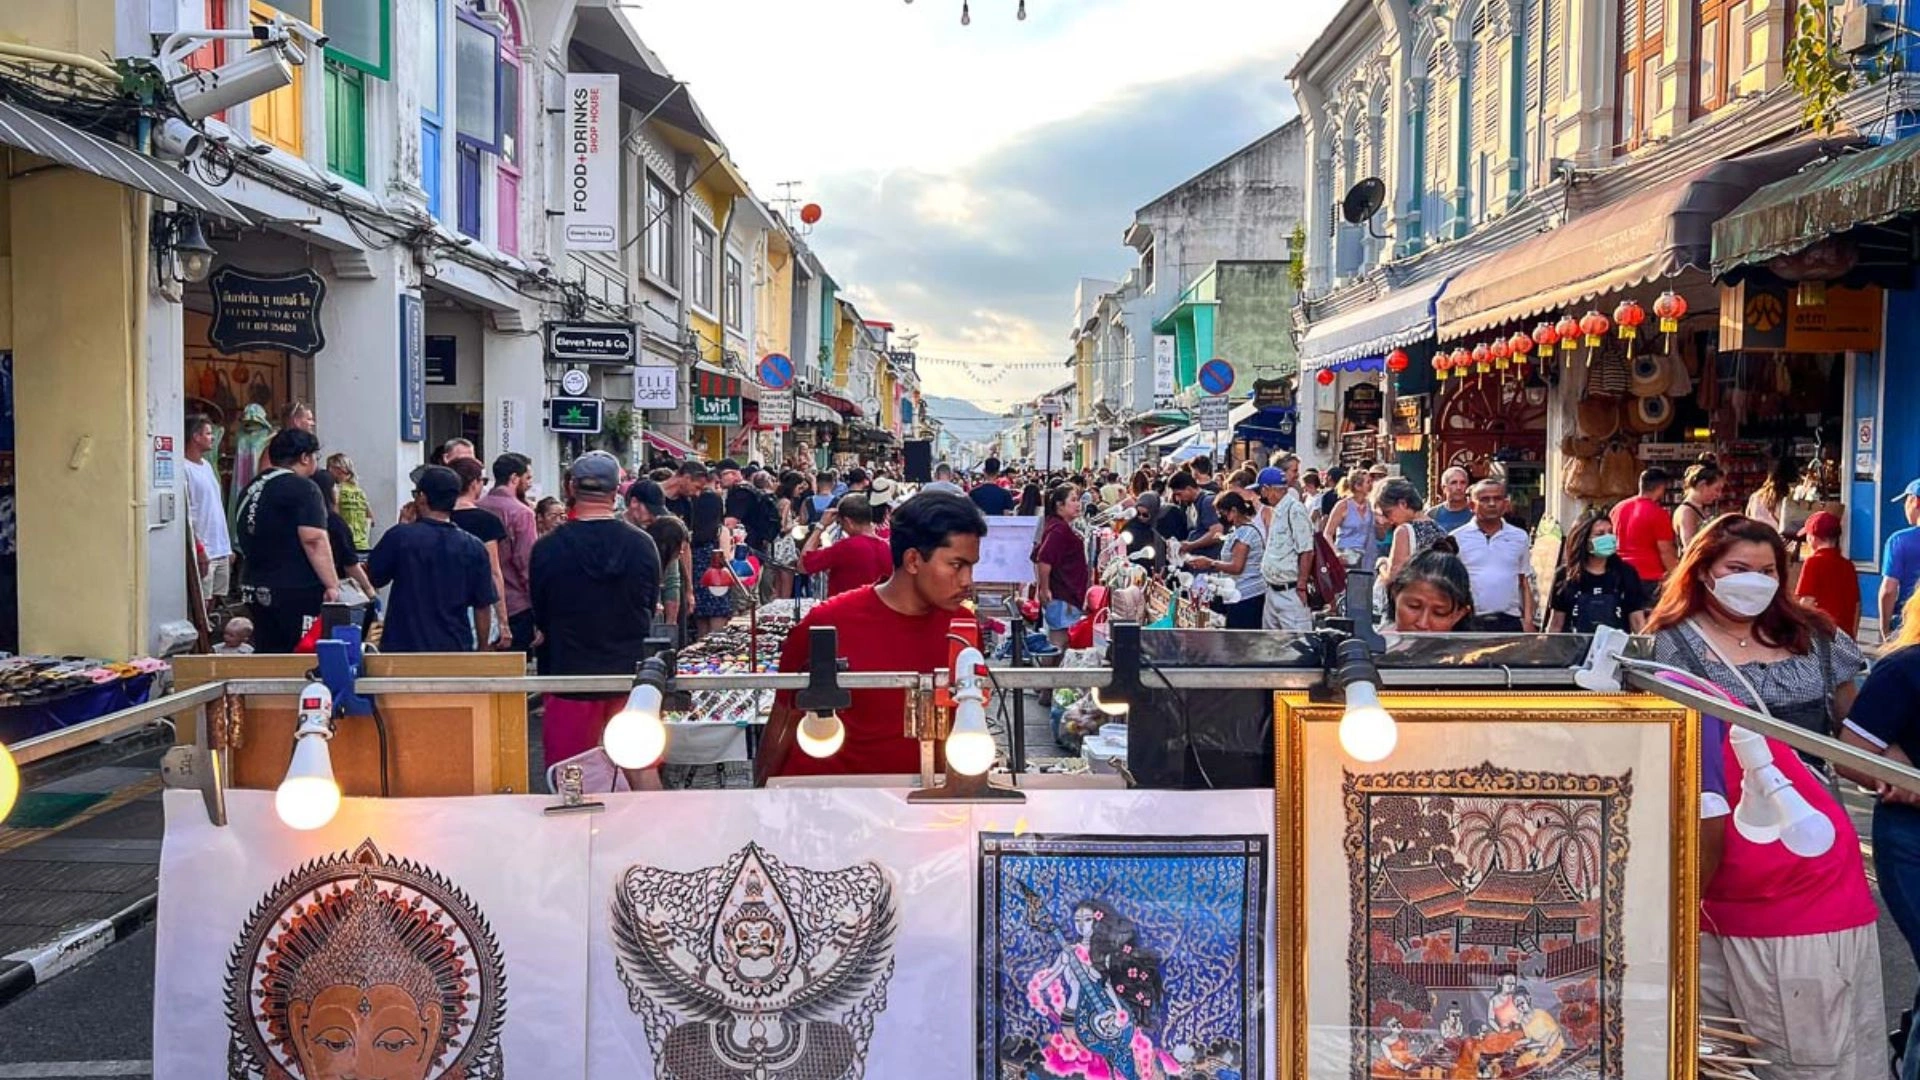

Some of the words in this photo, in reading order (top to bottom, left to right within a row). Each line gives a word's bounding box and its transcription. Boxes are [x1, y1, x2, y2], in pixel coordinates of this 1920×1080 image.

[590, 88, 600, 122] HOUSE
[574, 88, 588, 212] FOOD+DRINKS
[590, 127, 600, 154] SHOP
[556, 337, 585, 346] Eleven
[586, 338, 604, 347] Two
[606, 340, 612, 348] &
[614, 340, 628, 348] Co.
[638, 376, 670, 387] ELLE
[638, 388, 670, 400] café
